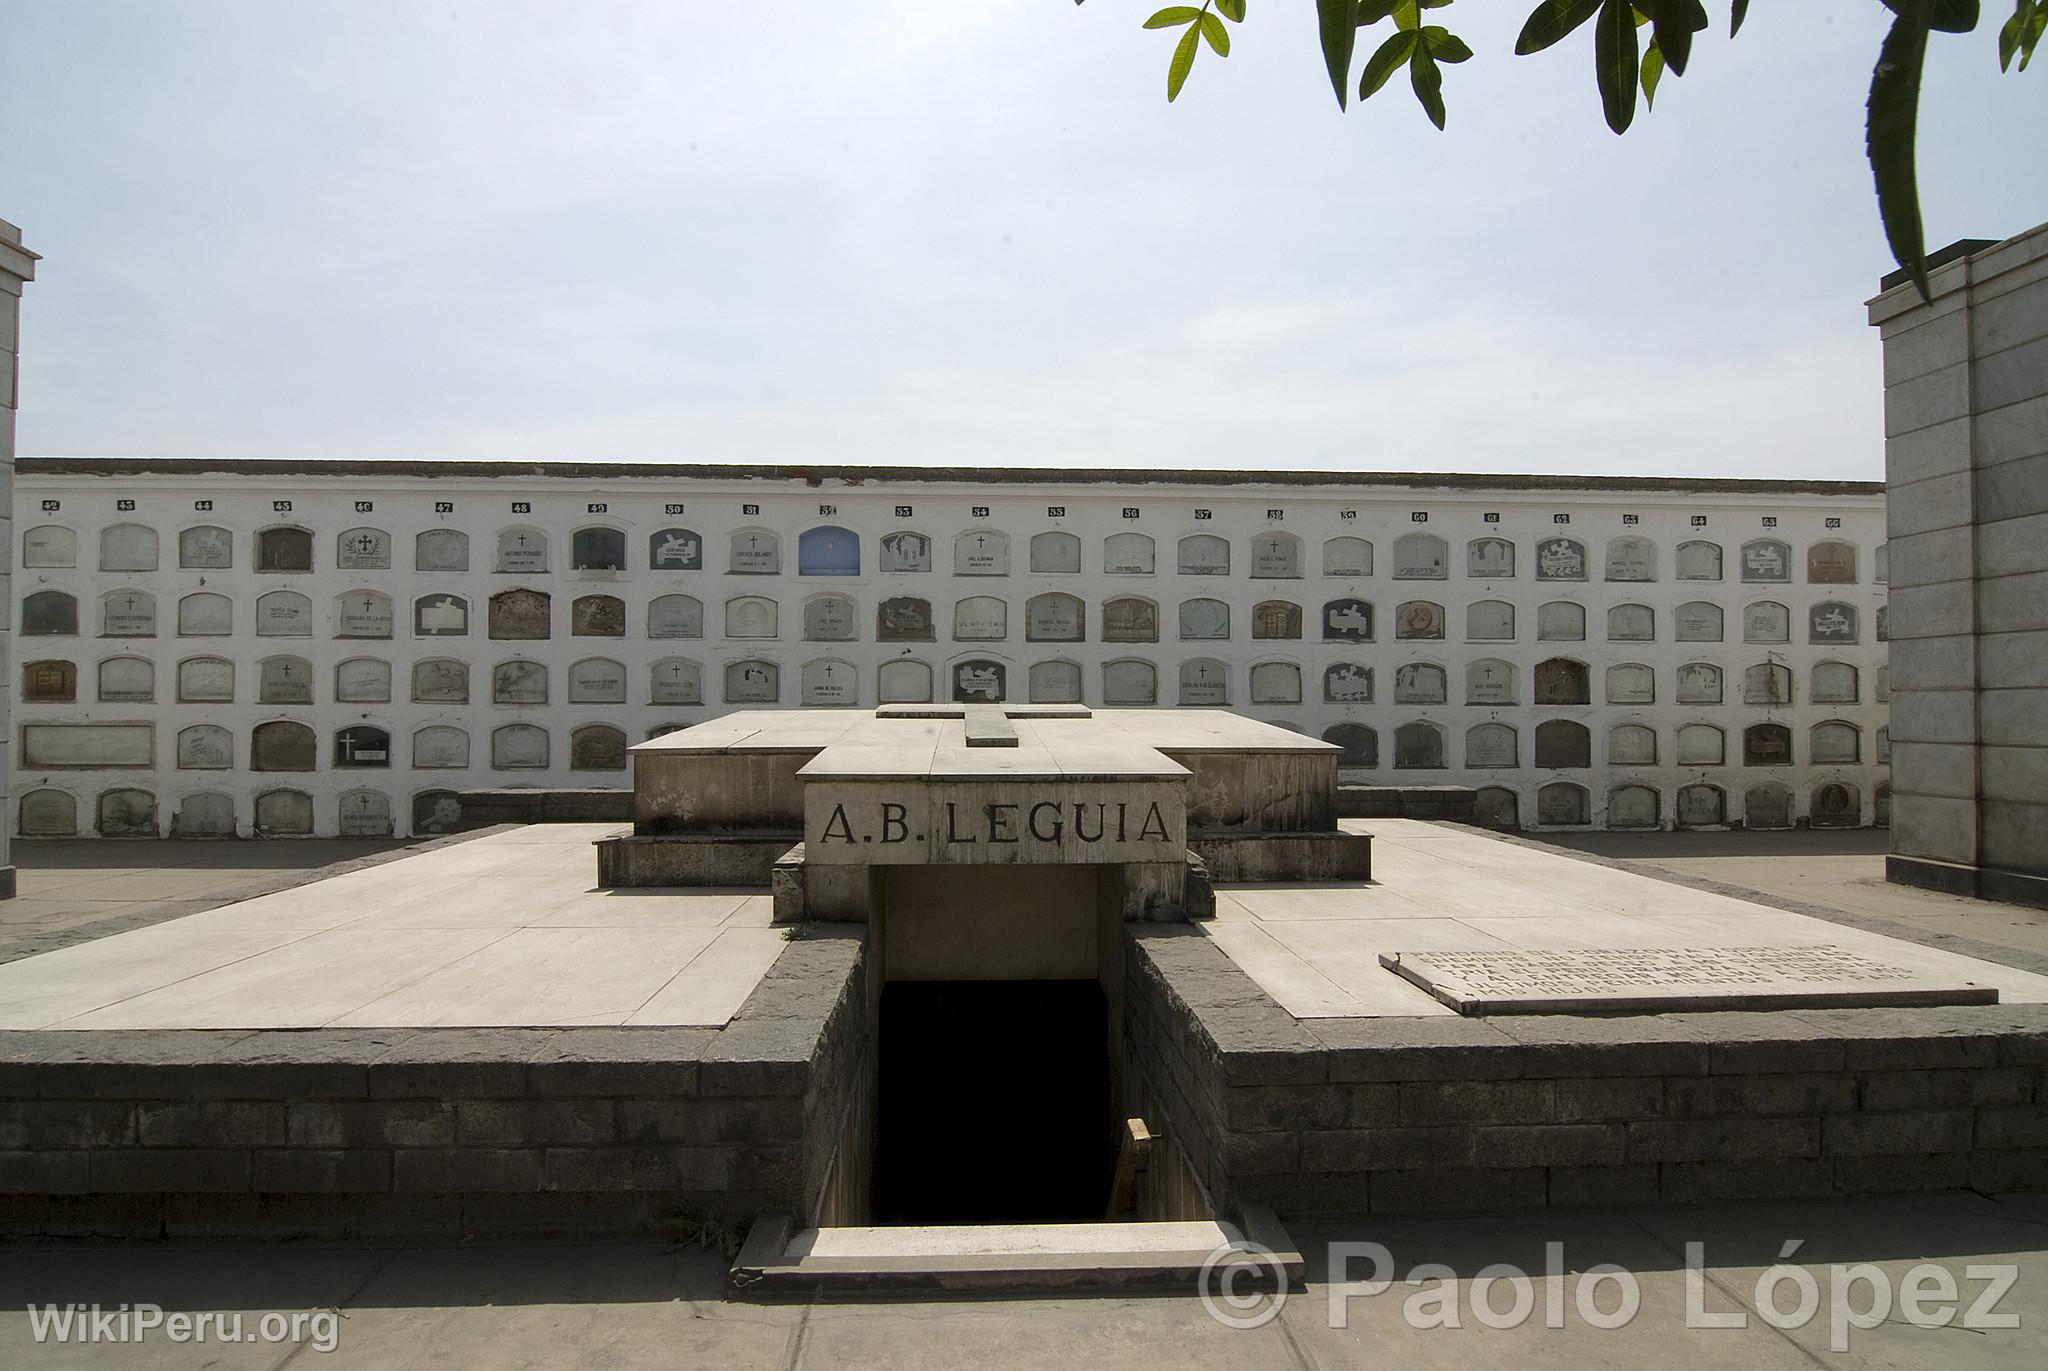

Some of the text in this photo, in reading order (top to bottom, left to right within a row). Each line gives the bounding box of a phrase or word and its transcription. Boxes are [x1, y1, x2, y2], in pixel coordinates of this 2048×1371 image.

[43, 500, 59, 510] 42
[118, 501, 134, 510] 43
[196, 501, 211, 511] 44
[275, 501, 291, 511] 45
[436, 503, 450, 513] 47
[513, 503, 528, 513] 48
[667, 504, 681, 514] 50
[746, 505, 757, 515] 51
[896, 507, 910, 516] 53
[1049, 507, 1064, 517] 55
[1123, 509, 1138, 518] 56
[1196, 510, 1210, 519] 57
[946, 801, 1173, 848] LEGUIA
[1564, 947, 1679, 955] CORAZON
[1526, 972, 1656, 980] ENTREGAR
[1465, 980, 1576, 988] ULTIMOS
[1585, 976, 1775, 986] PENSAMIENTOS
